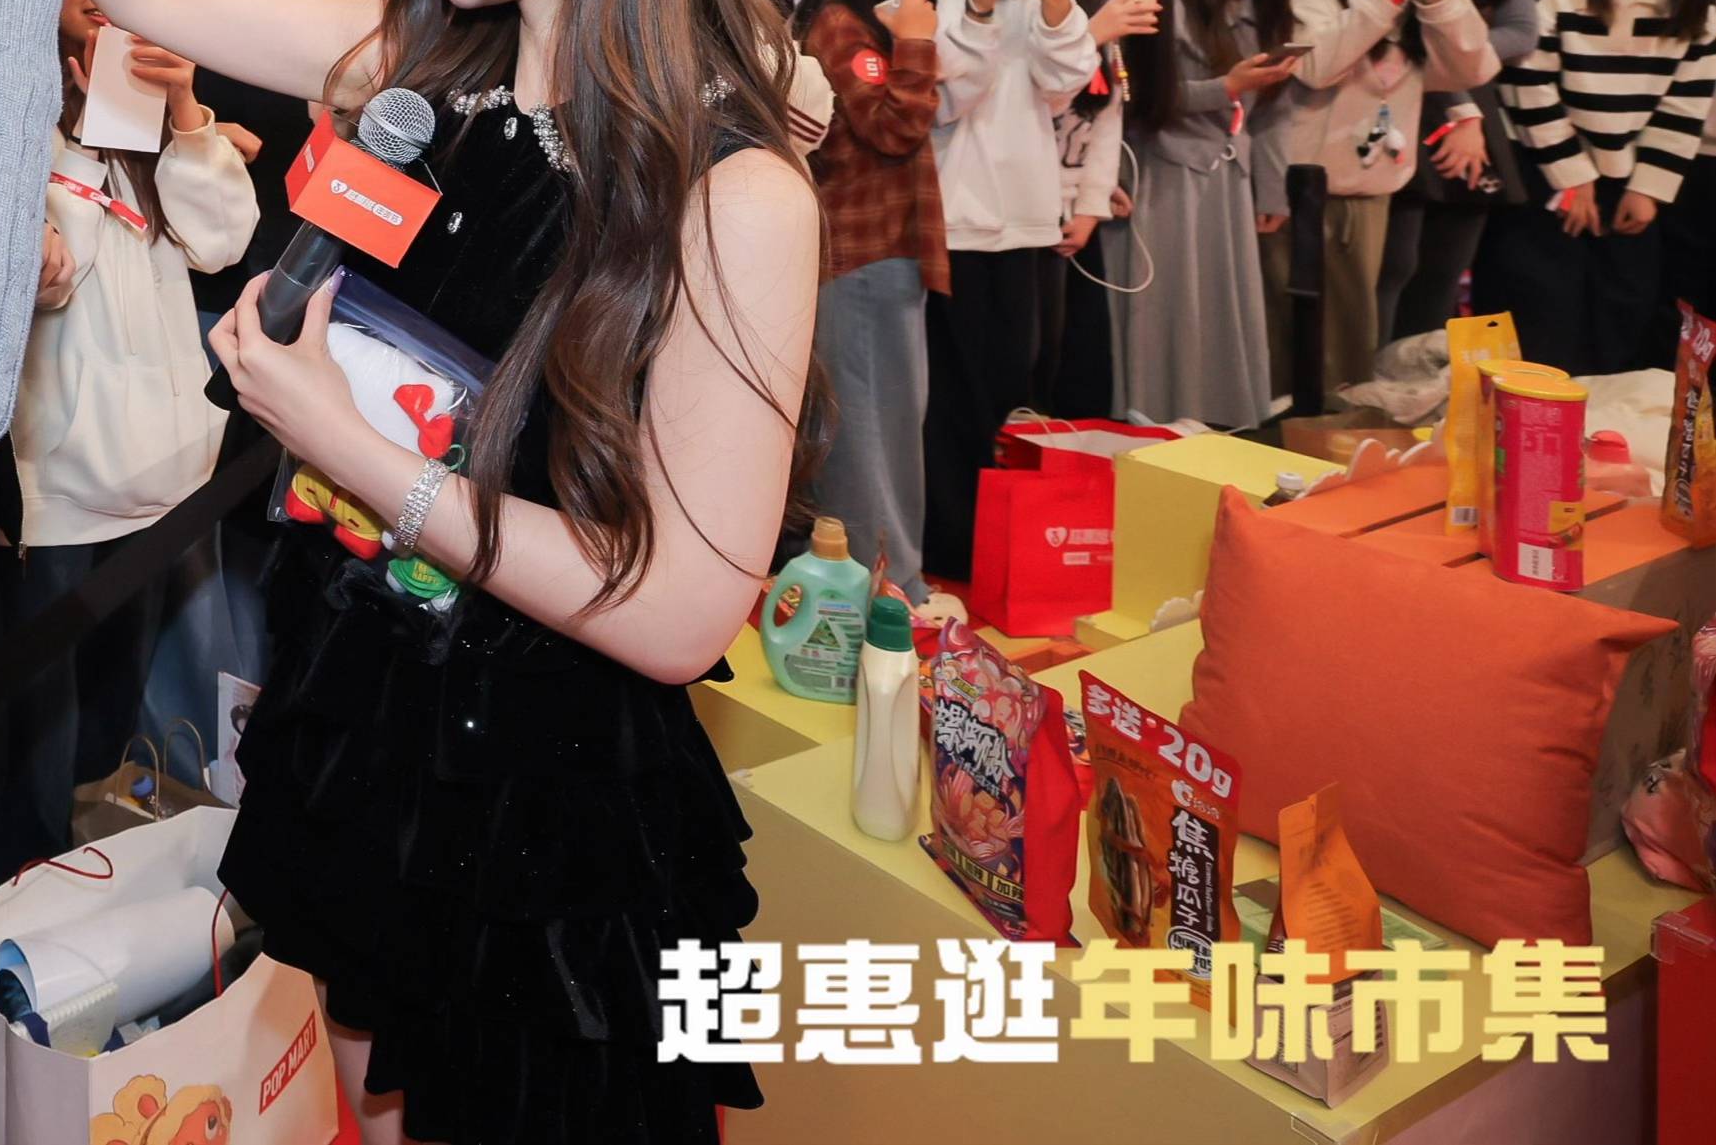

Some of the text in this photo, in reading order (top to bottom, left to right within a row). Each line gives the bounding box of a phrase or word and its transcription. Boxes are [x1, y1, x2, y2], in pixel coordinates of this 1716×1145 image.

[1157, 724, 1233, 800] 20g
[260, 1017, 318, 1108] POP MART
